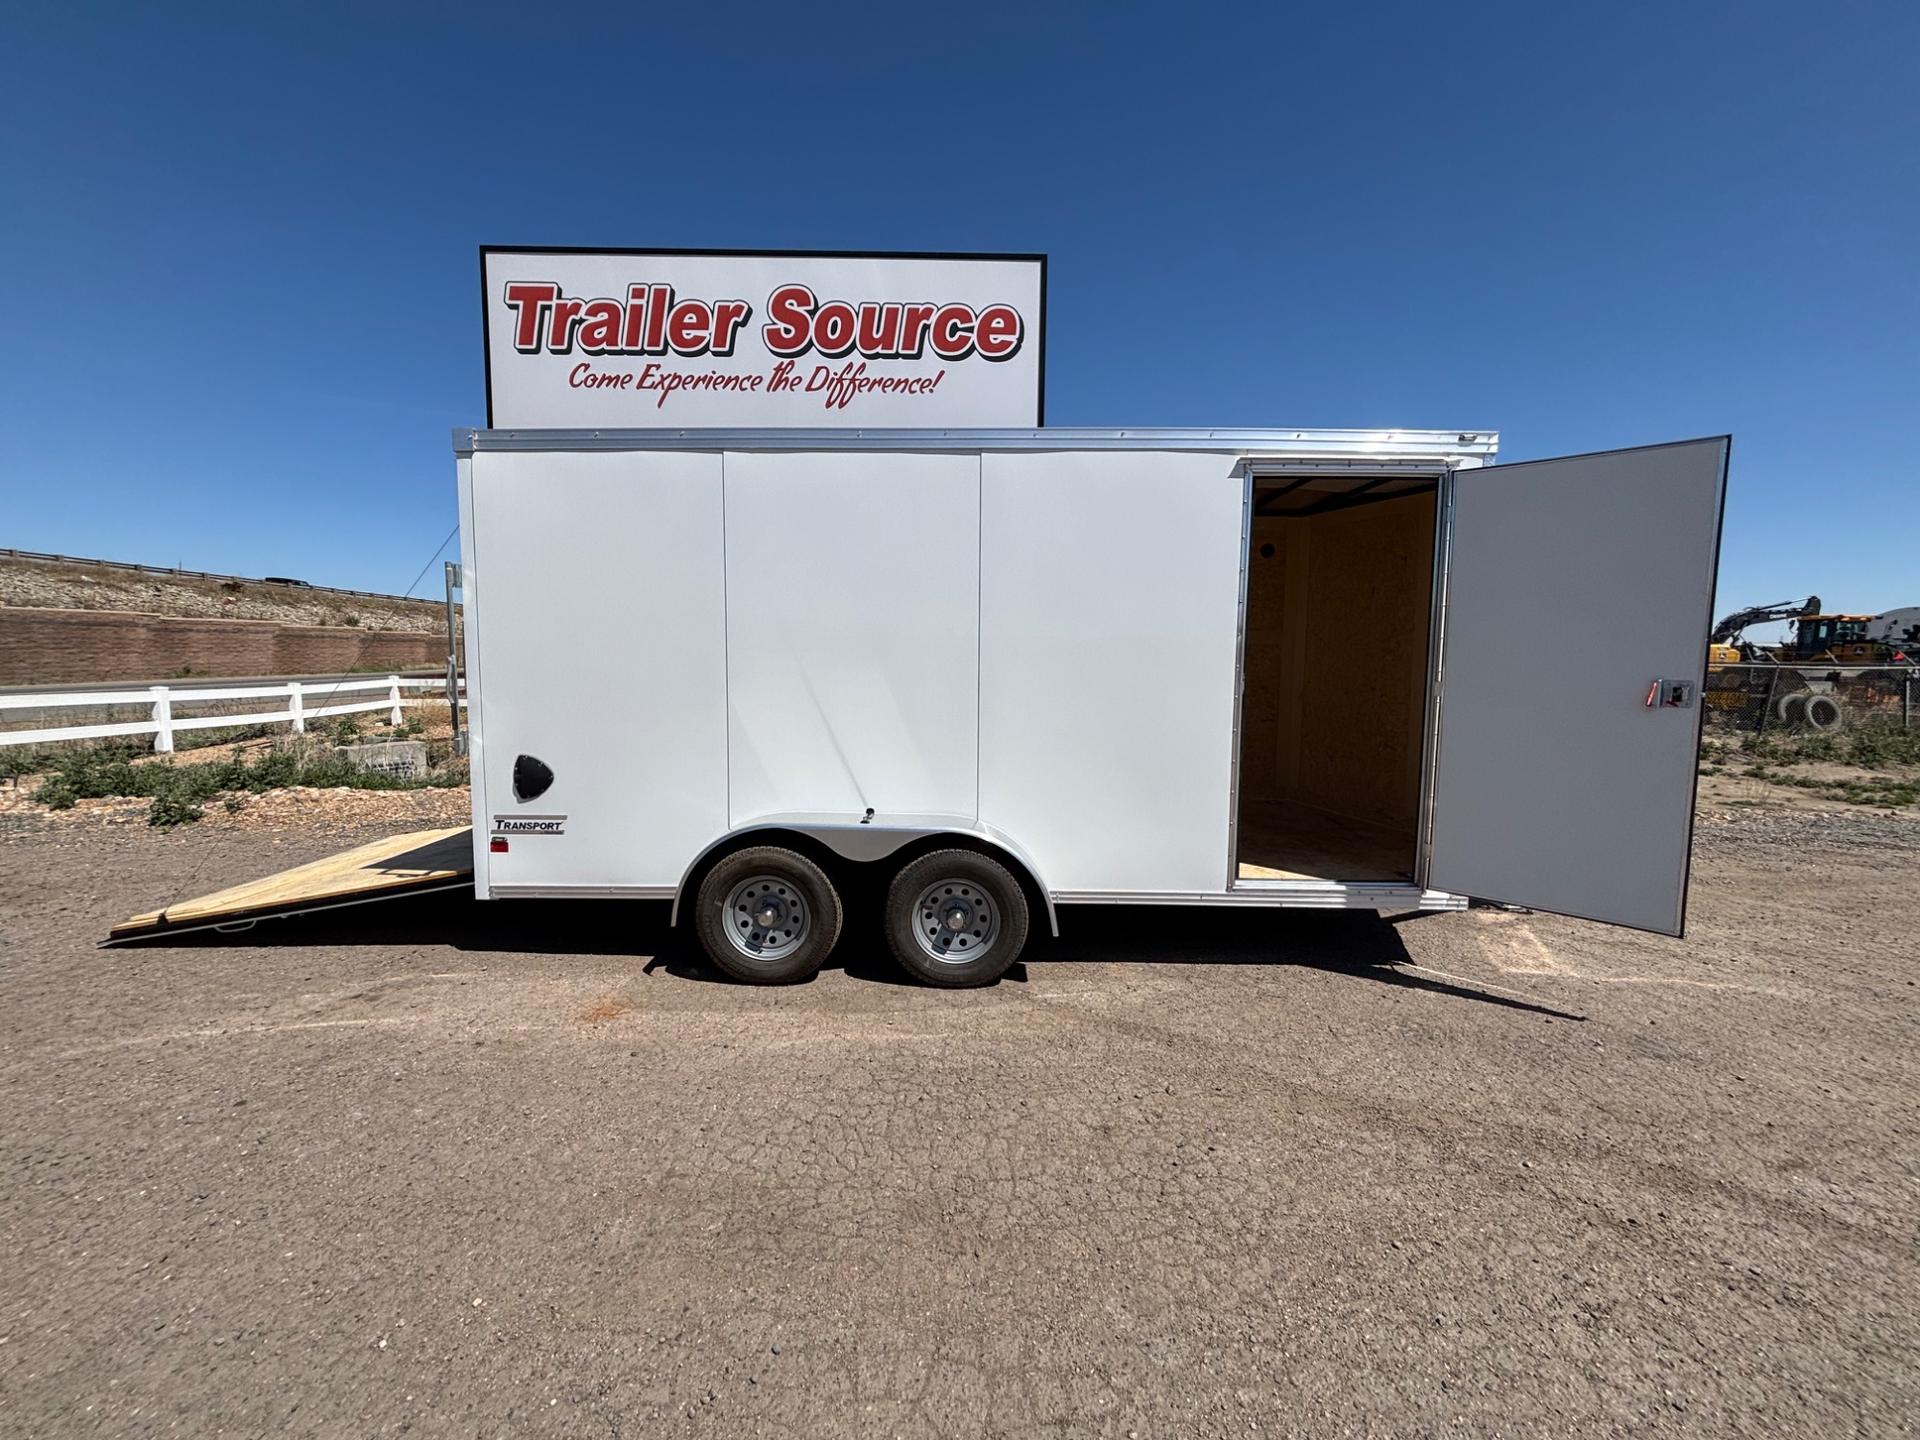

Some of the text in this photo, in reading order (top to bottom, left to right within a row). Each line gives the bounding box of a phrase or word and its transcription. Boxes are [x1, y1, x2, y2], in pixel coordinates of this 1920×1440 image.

[505, 281, 1024, 361] Trailer Source
[569, 359, 945, 409] Come Experience the Difference!
